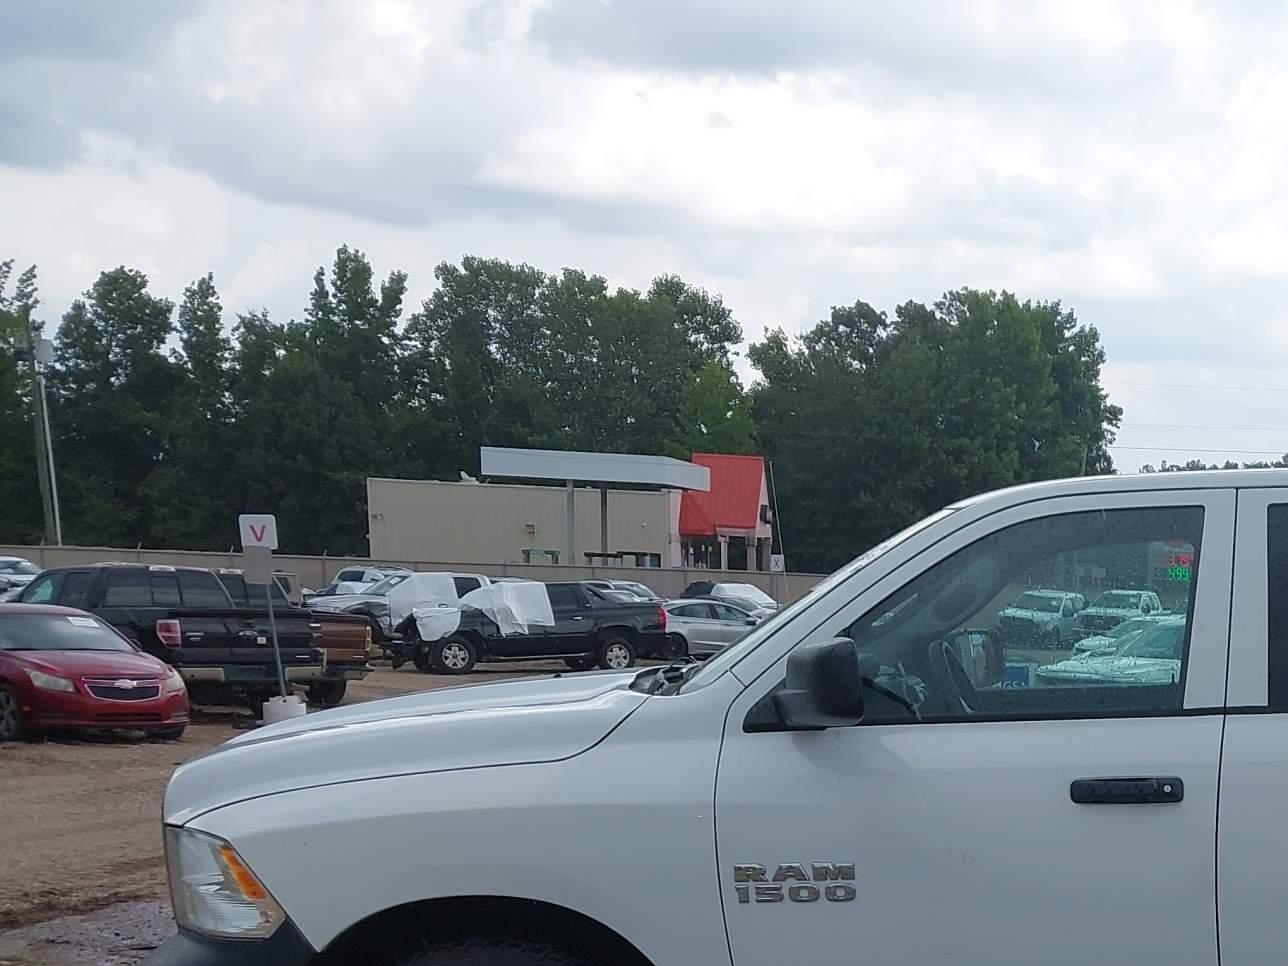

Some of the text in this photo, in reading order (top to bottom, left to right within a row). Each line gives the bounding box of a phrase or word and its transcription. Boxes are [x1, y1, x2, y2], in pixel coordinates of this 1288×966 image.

[249, 524, 266, 542] V
[733, 862, 856, 882] RAM
[735, 883, 857, 903] 1500
